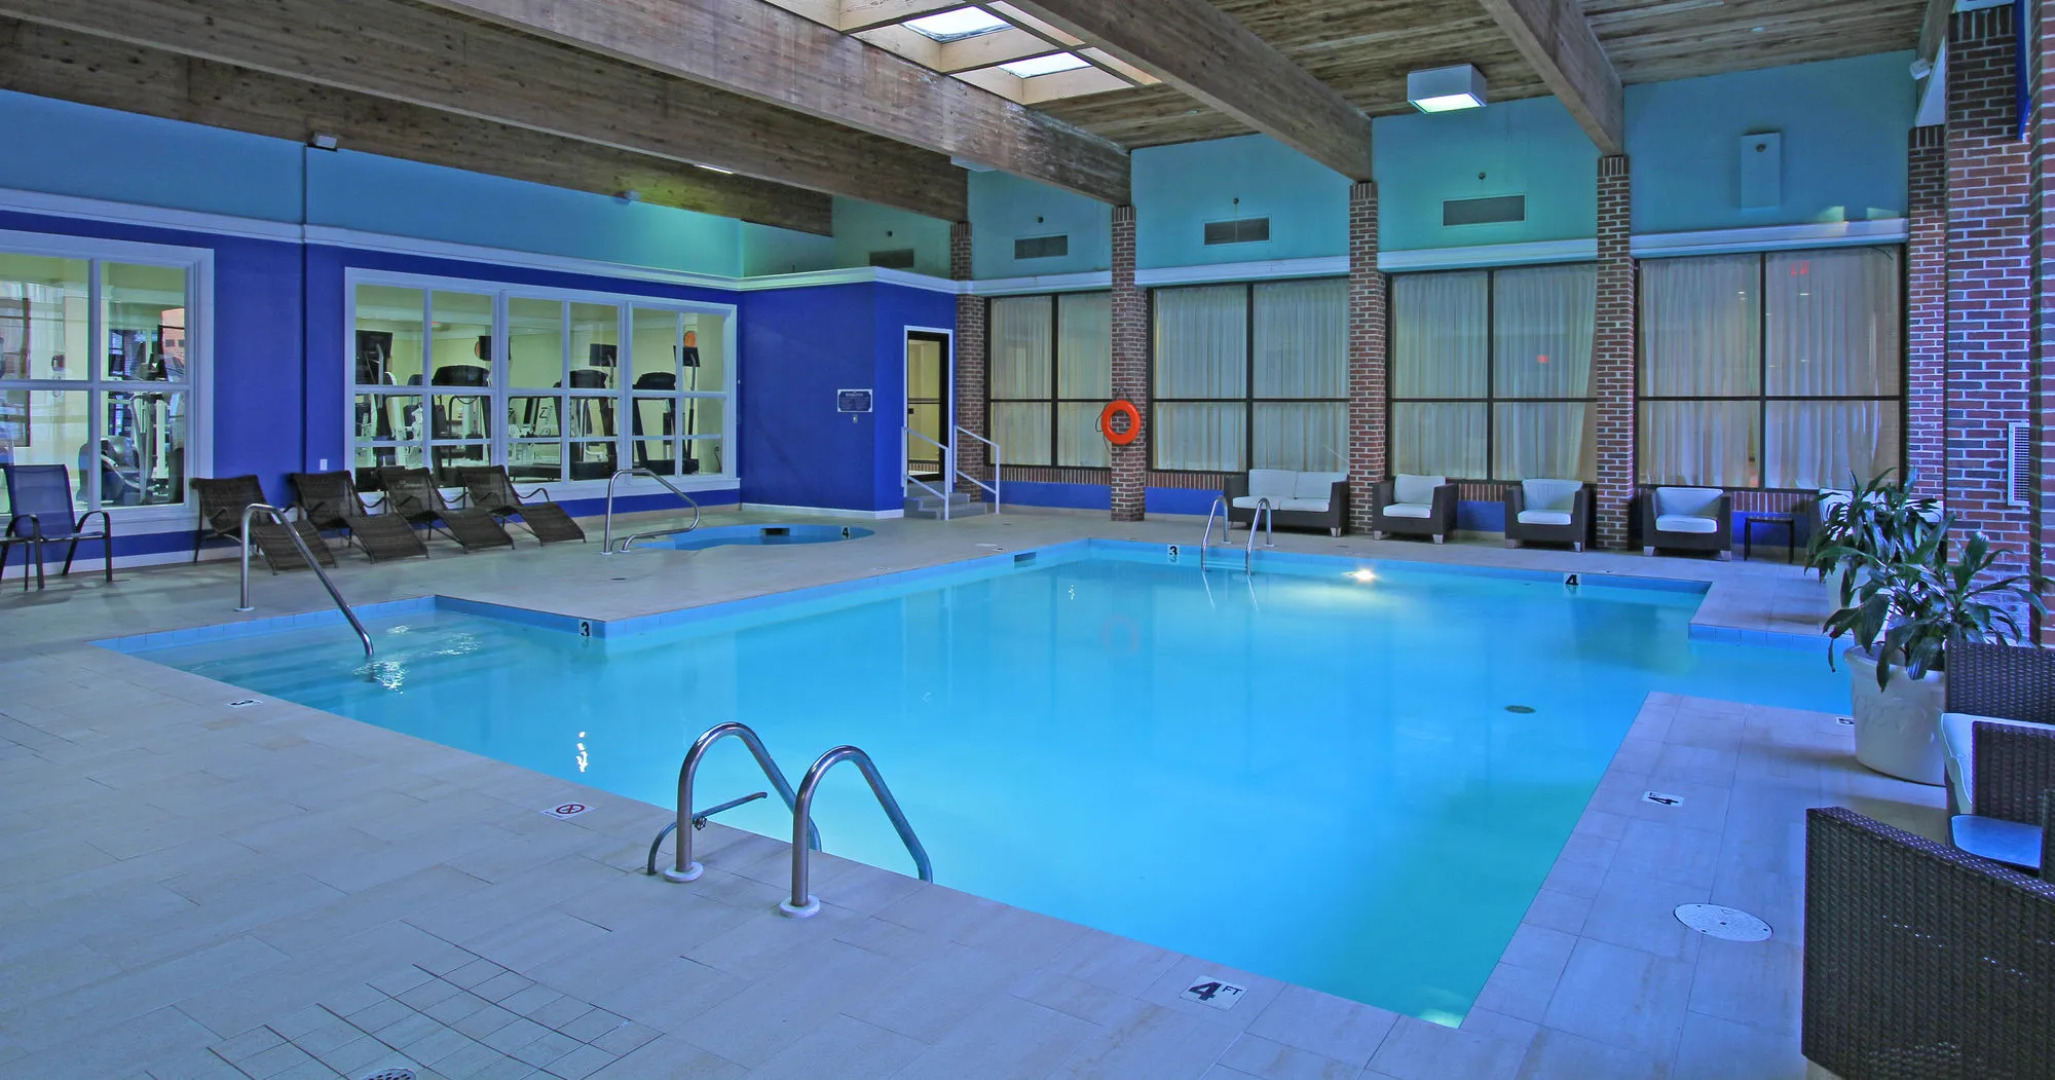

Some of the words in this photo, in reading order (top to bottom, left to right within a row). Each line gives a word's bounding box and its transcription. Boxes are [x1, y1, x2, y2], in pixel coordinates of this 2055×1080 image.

[842, 526, 849, 539] 4
[1169, 545, 1178, 556] 3
[1565, 574, 1579, 586] 4
[581, 621, 590, 636] 3
[1188, 981, 1222, 1001] 4
[1222, 985, 1243, 996] FT
